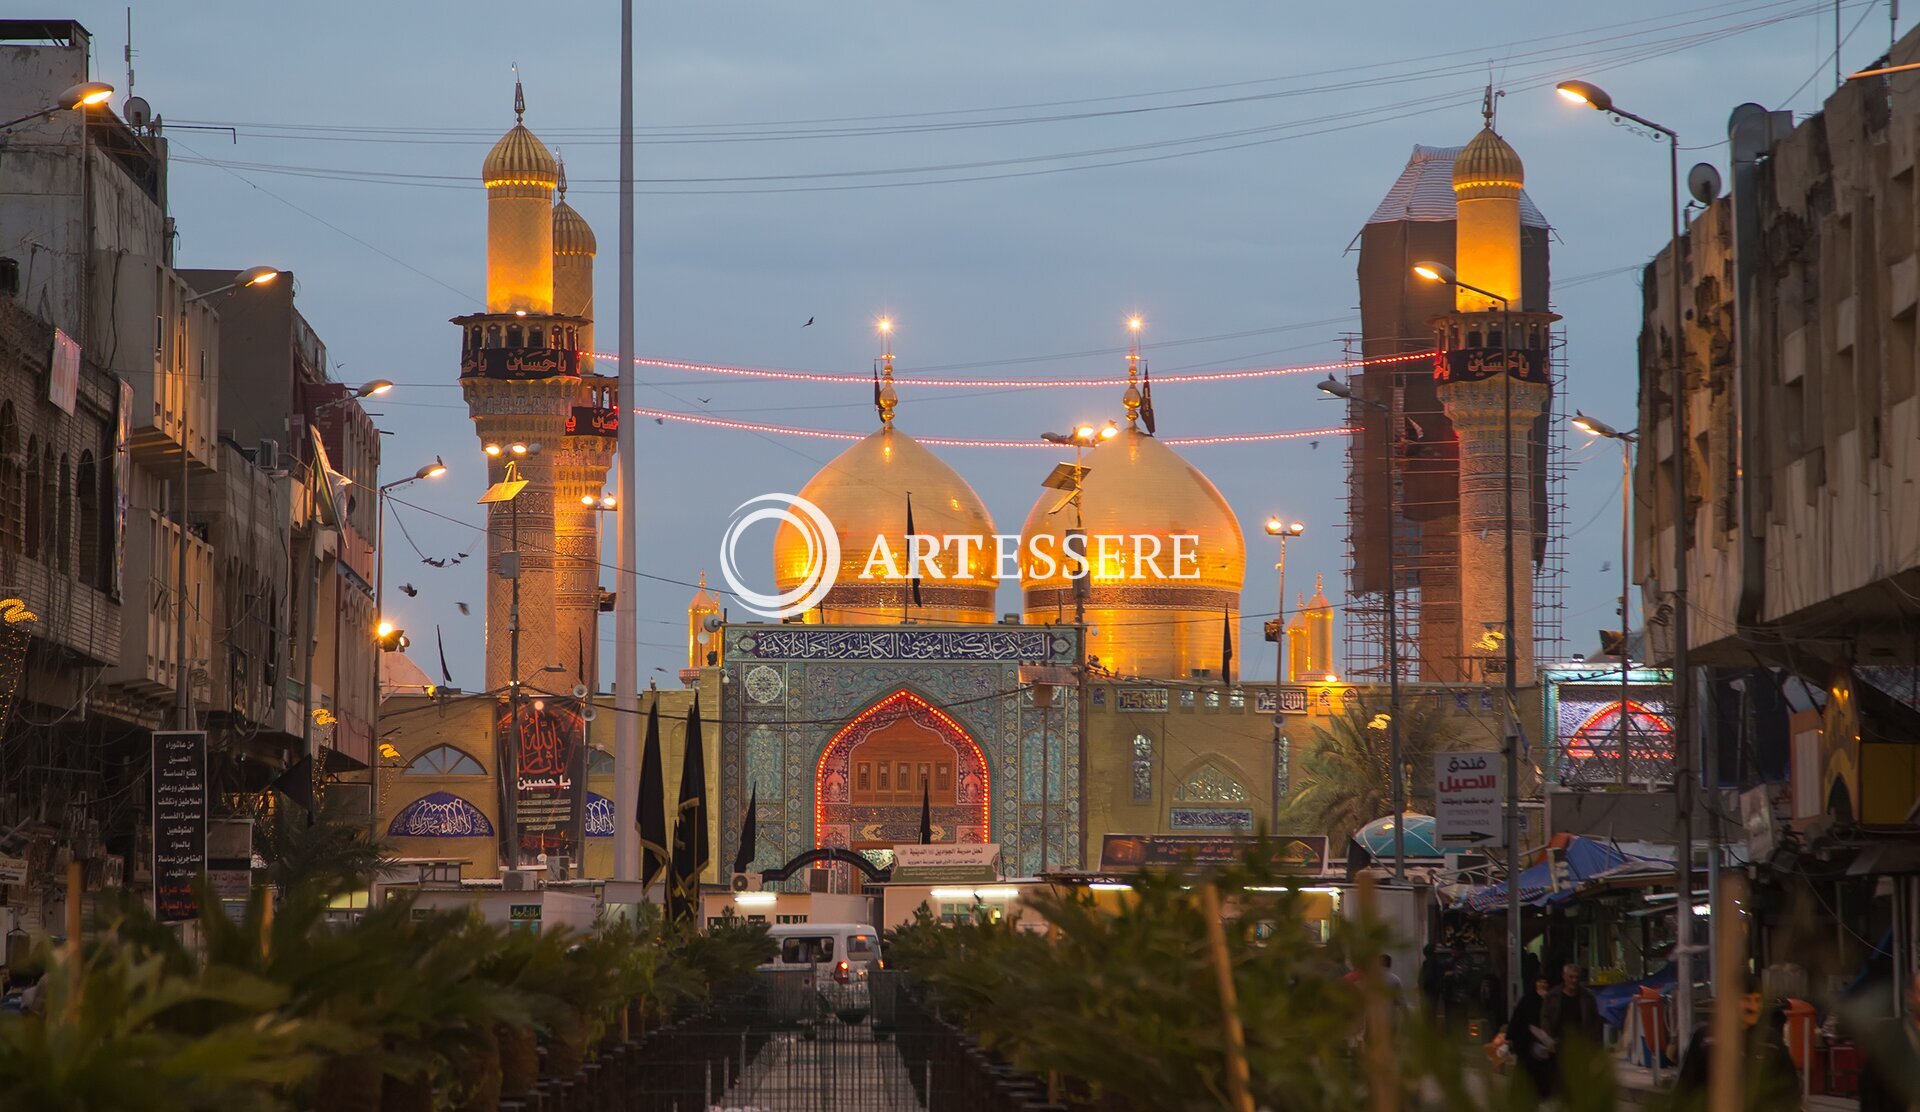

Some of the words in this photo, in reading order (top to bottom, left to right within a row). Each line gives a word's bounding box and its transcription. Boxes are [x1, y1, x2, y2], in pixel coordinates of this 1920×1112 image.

[1447, 756, 1487, 773] فندق
[516, 775, 557, 790] حسين
[559, 774, 572, 790] يا
